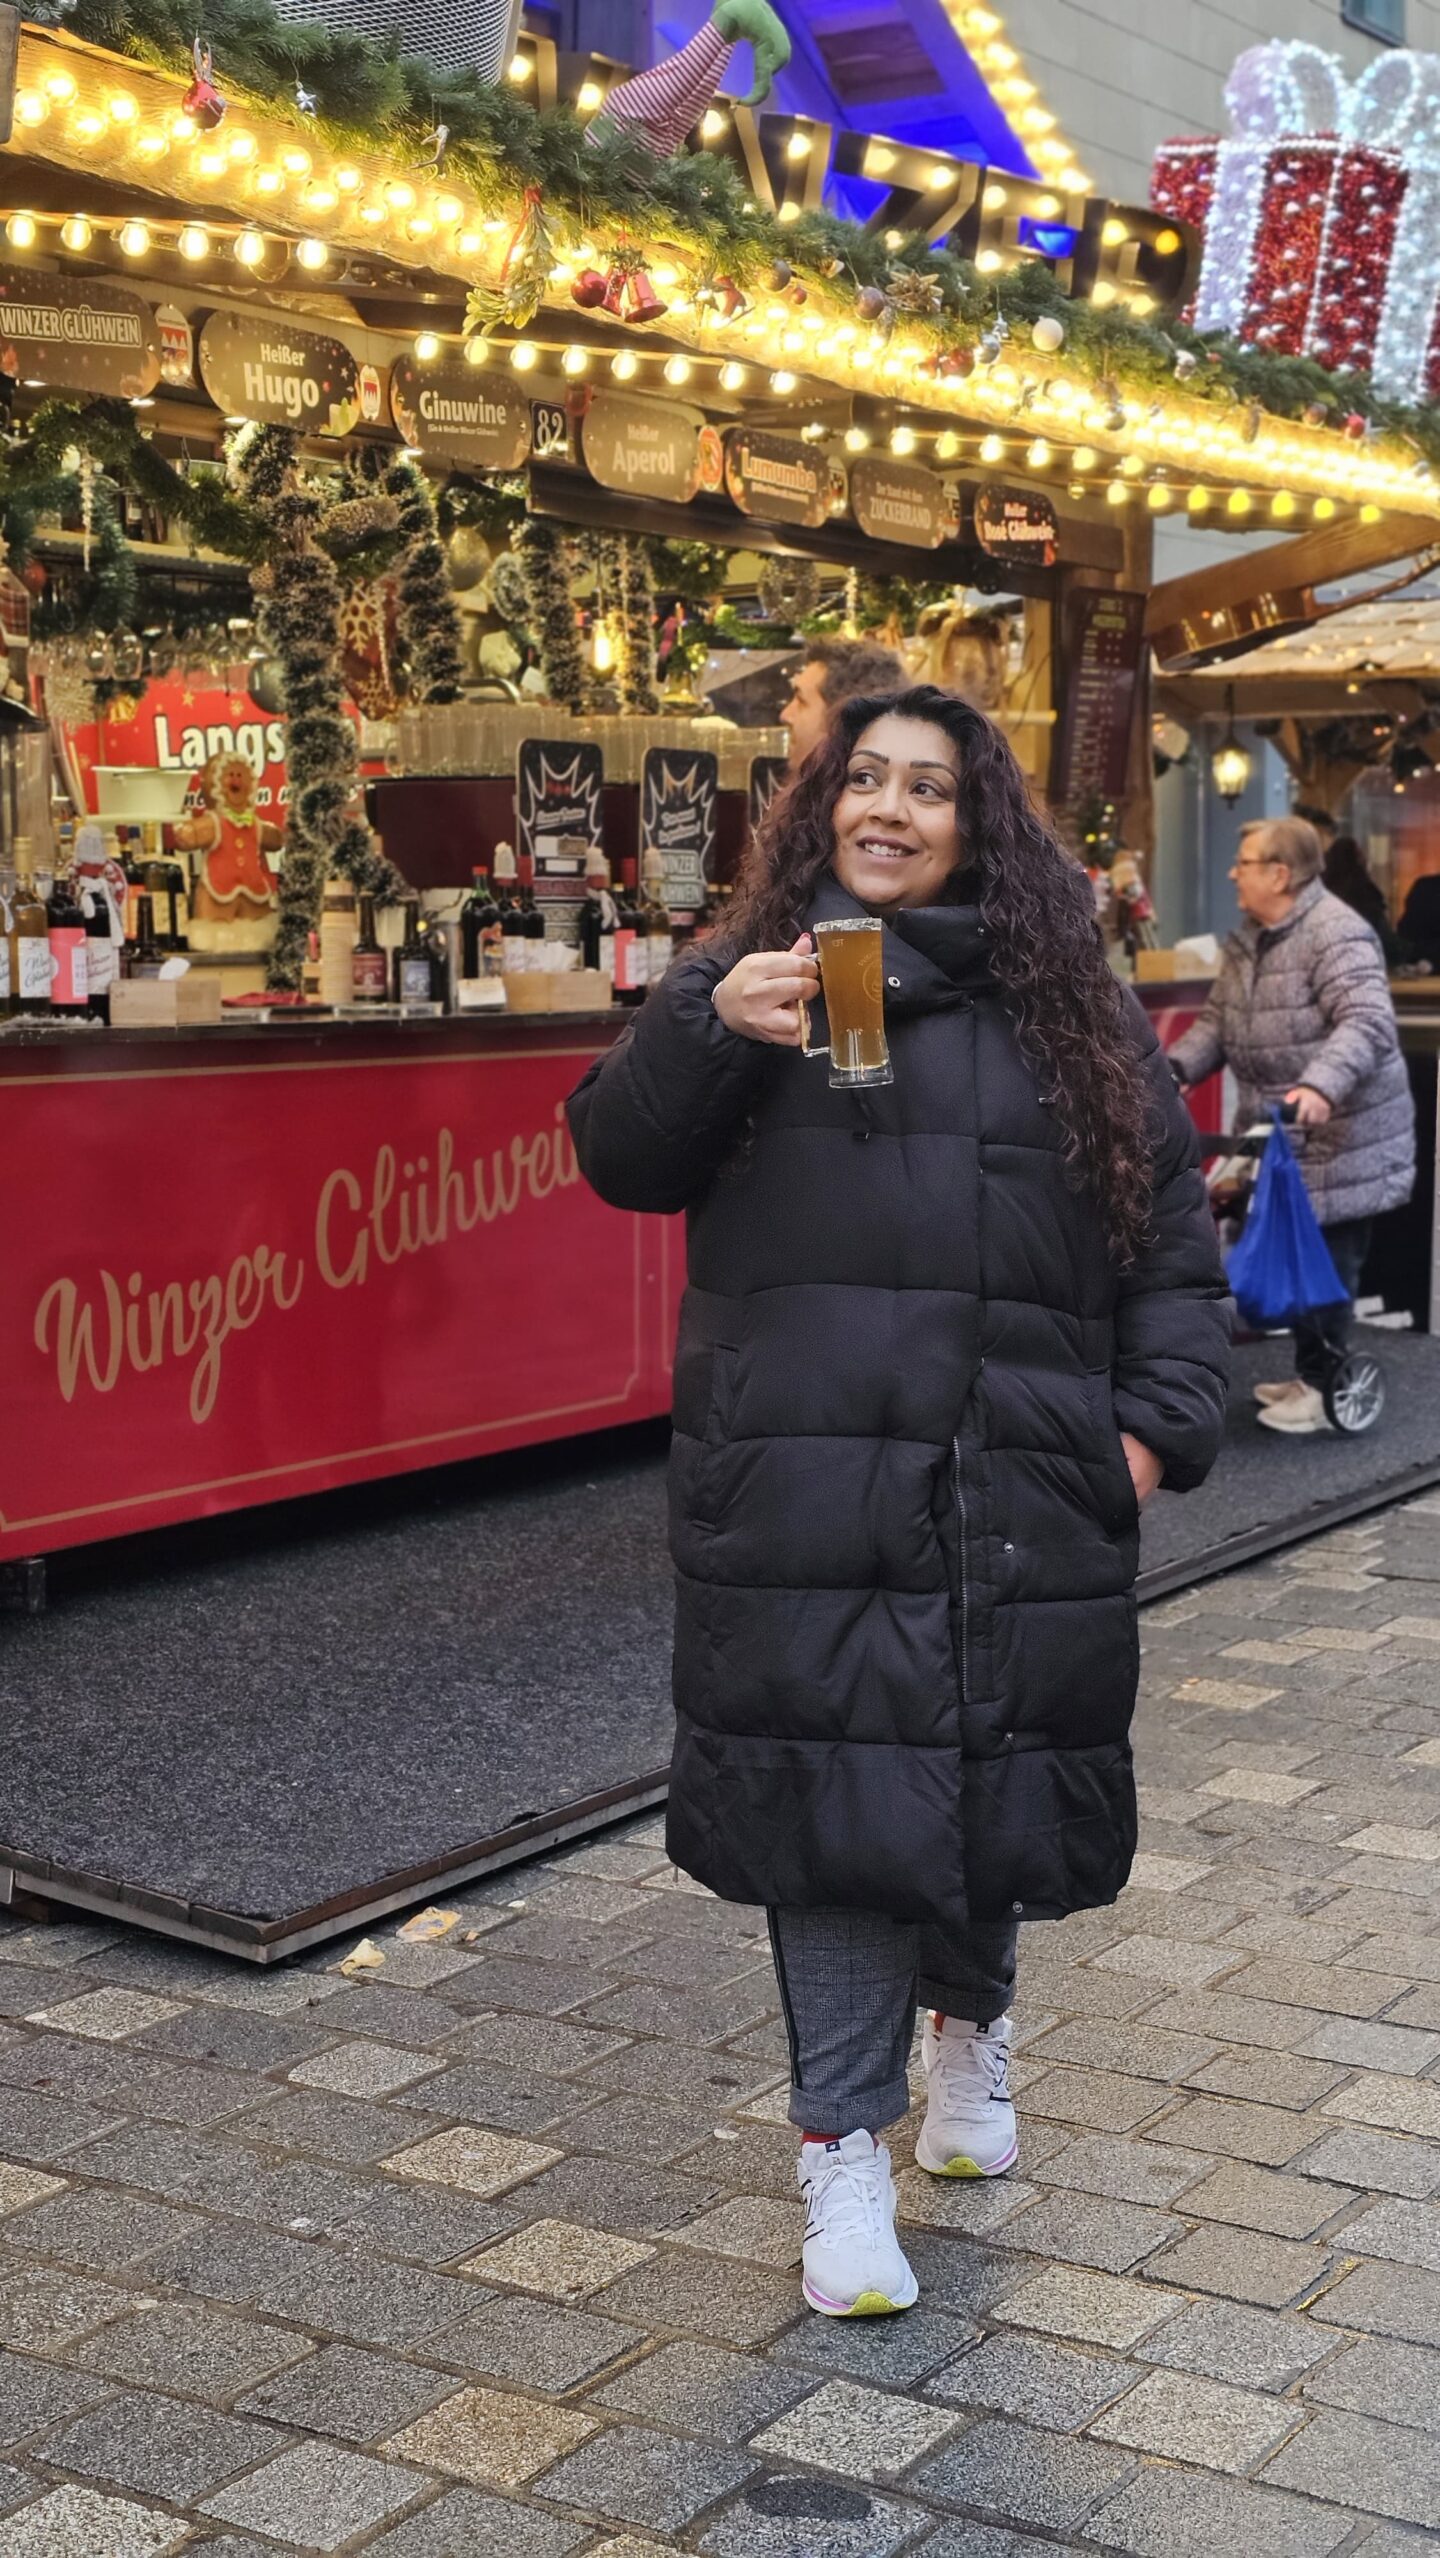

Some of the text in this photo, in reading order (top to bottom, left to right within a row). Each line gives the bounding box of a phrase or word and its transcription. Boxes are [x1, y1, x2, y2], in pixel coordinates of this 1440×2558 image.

[0, 305, 141, 345] WINZER GLÜHWEIN
[260, 343, 305, 366] Heißer
[243, 362, 319, 418] Hugo
[419, 390, 506, 425] Ginuwine
[537, 408, 564, 455] 82
[627, 424, 659, 443] Heißer
[612, 443, 676, 482] Aperol
[741, 447, 817, 493] Lumumba
[33, 1243, 304, 1425] Winzer
